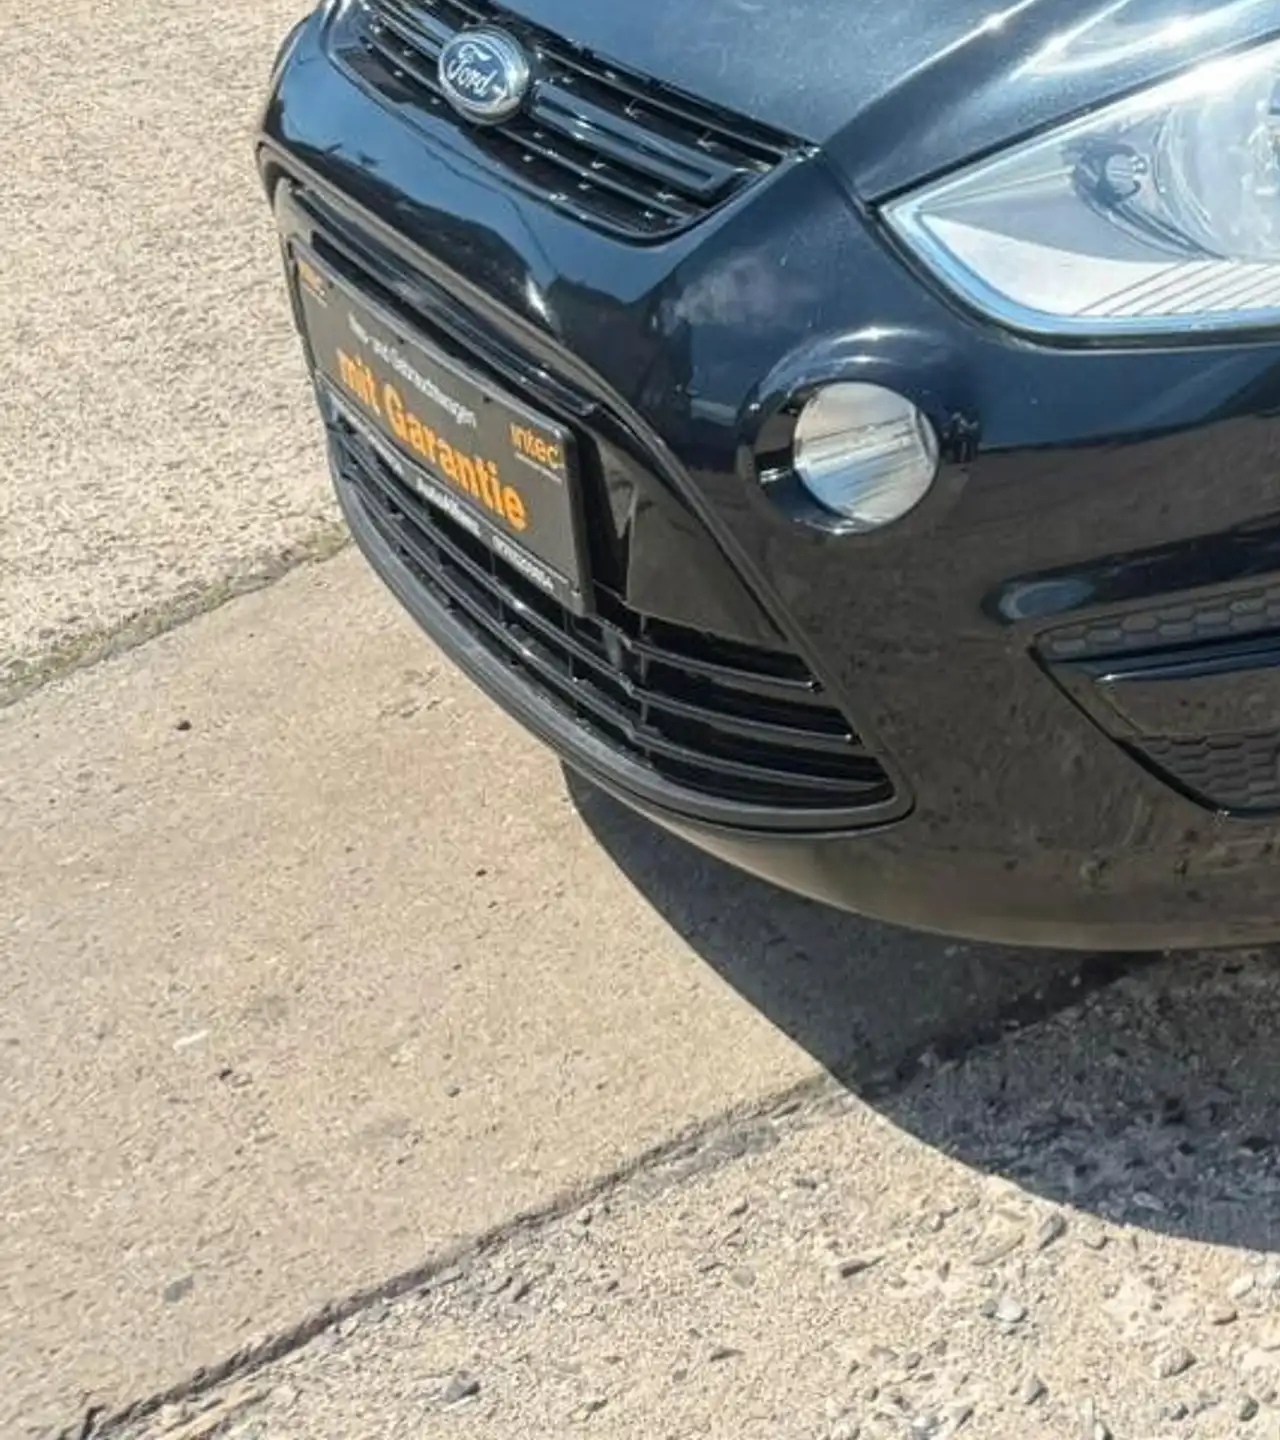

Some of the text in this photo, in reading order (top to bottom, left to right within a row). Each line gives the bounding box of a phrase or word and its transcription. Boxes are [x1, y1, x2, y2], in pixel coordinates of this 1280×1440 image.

[446, 44, 498, 97] Ford
[336, 347, 380, 416] mit
[384, 383, 527, 532] Garantie
